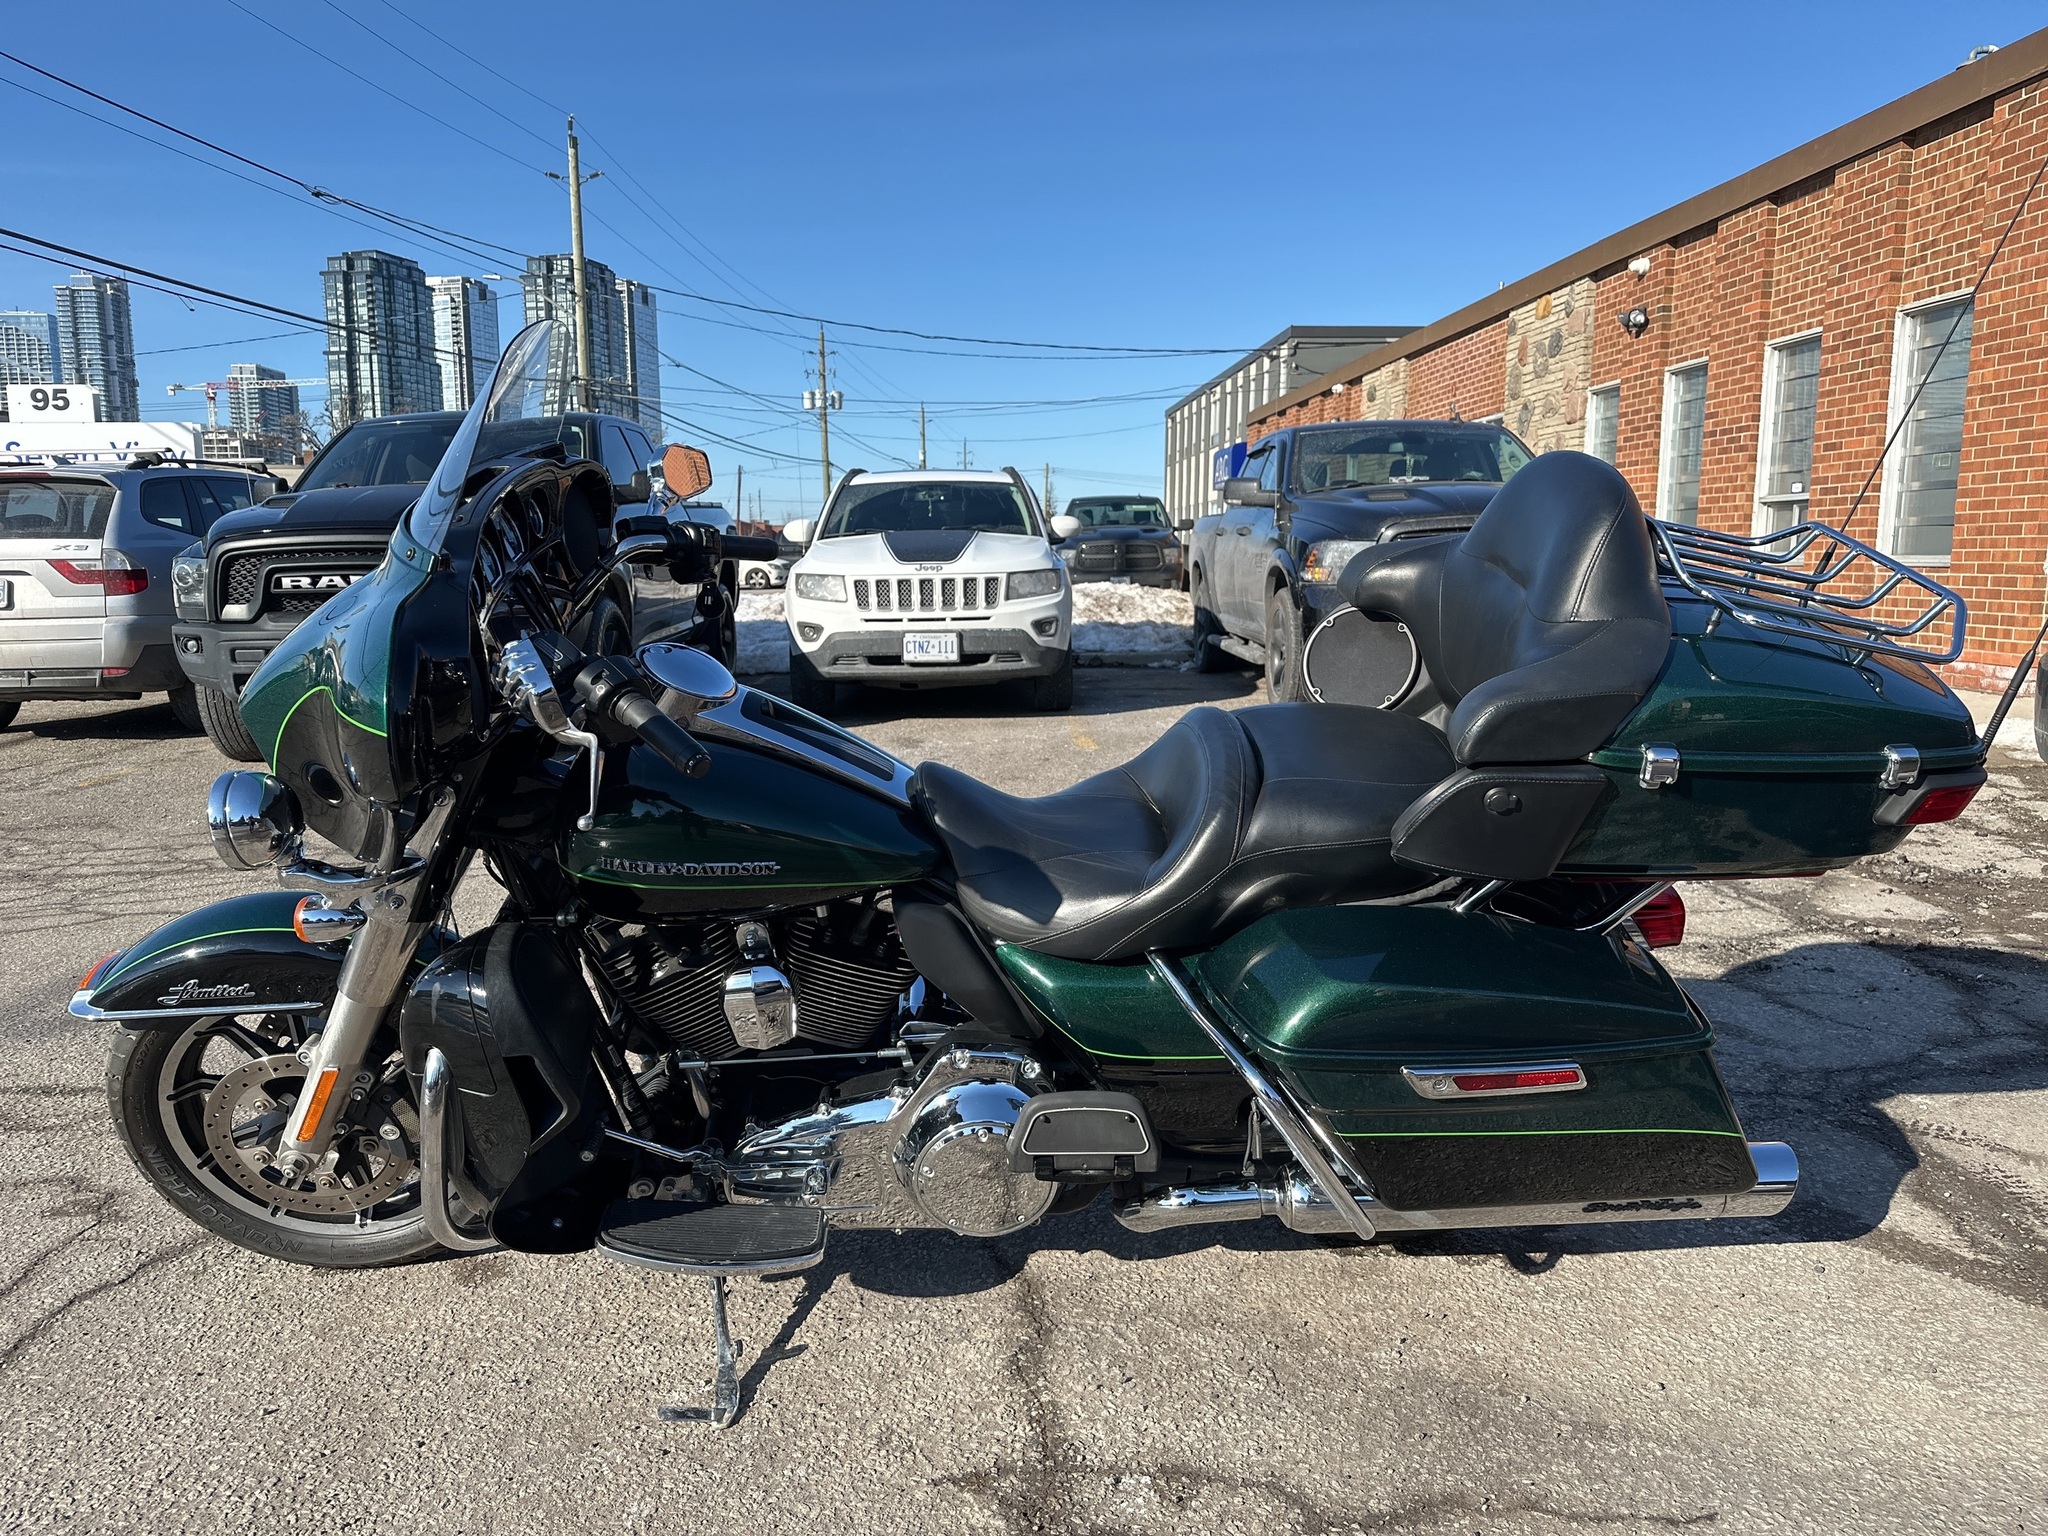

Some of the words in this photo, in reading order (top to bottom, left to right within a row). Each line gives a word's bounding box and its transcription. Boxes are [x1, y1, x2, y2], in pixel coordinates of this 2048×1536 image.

[30, 388, 70, 411] 95
[914, 563, 943, 572] Jeep
[905, 640, 930, 654] CTNZ
[938, 640, 955, 654] 111
[157, 979, 256, 1006] Limited
[143, 1143, 199, 1199] NIGHT
[196, 1203, 303, 1255] DRAGON
